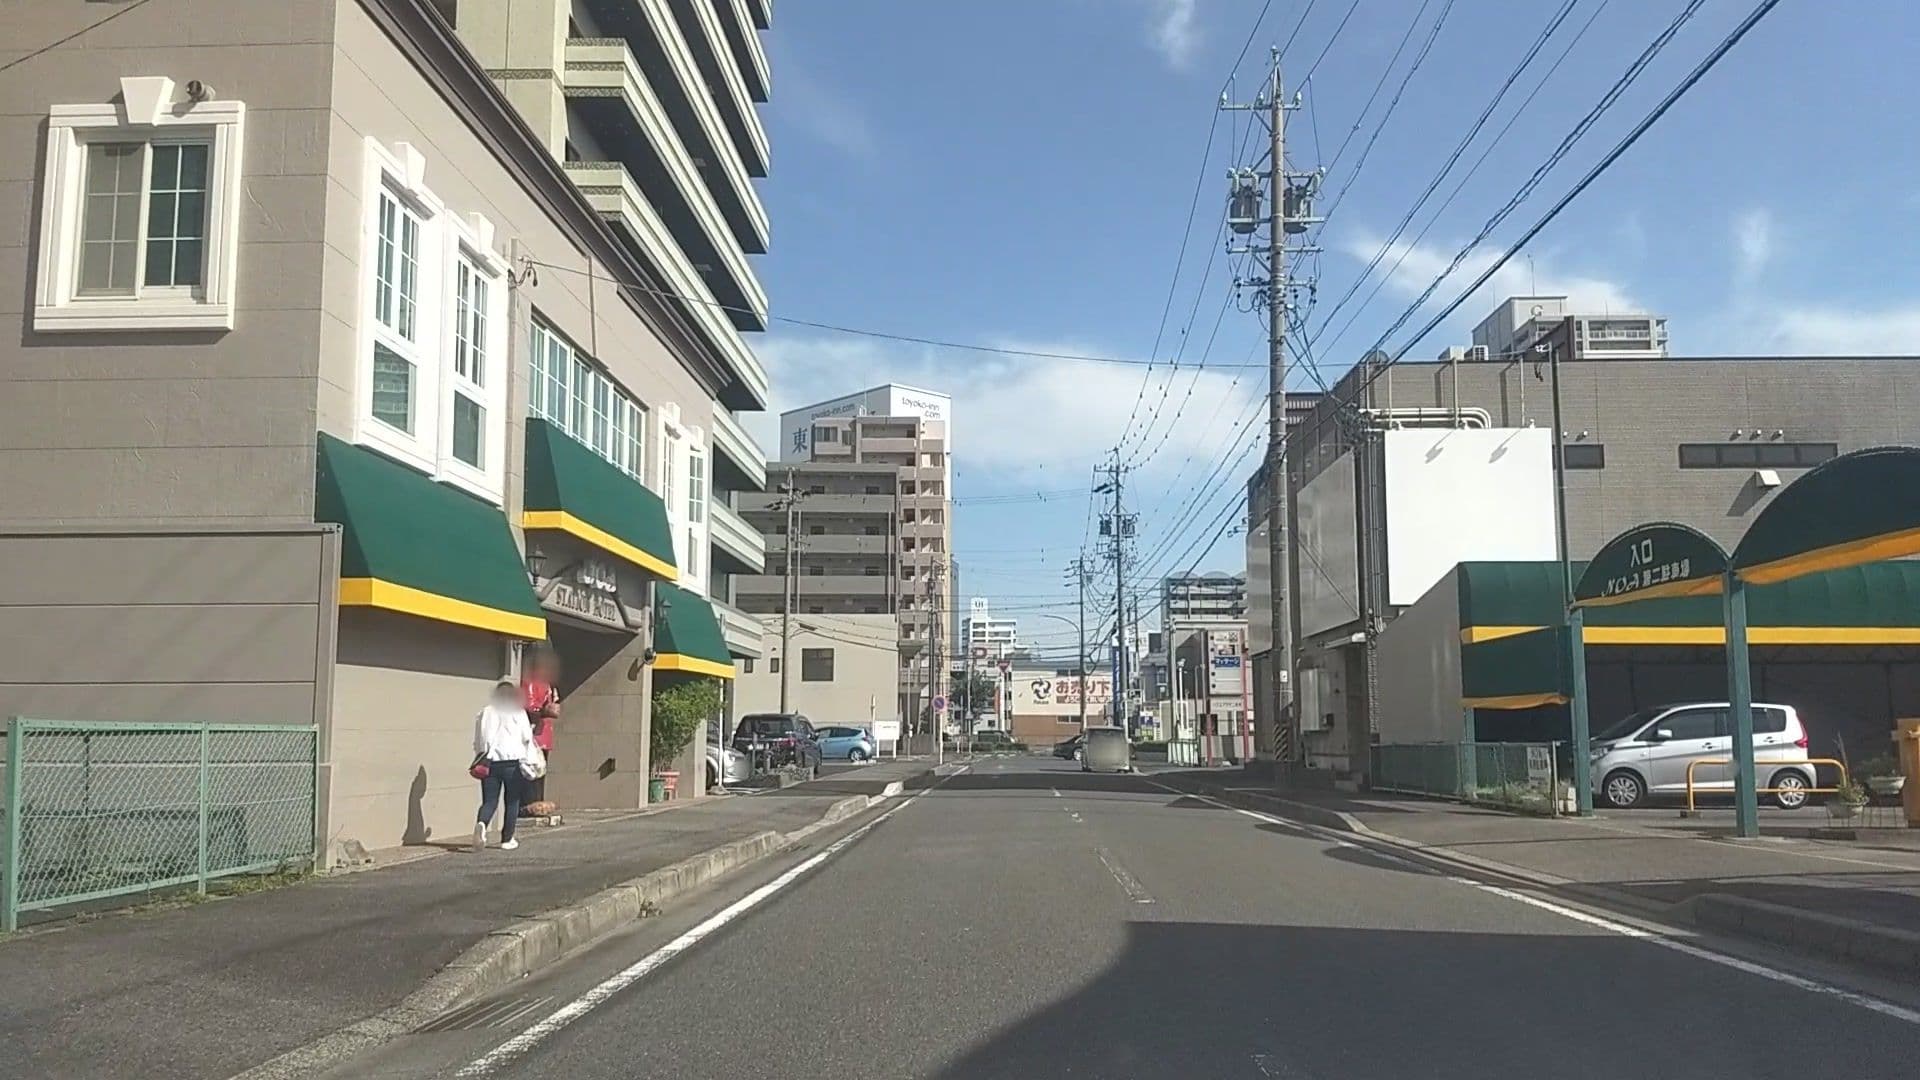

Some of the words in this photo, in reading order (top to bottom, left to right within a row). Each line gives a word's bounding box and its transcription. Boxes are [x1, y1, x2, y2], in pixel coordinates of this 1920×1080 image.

[902, 396, 940, 412] toyoko-inn
[792, 427, 808, 454] 東
[1630, 538, 1653, 568] 入口
[1601, 572, 1639, 597] NOA
[1642, 558, 1690, 587] 第二駐車場
